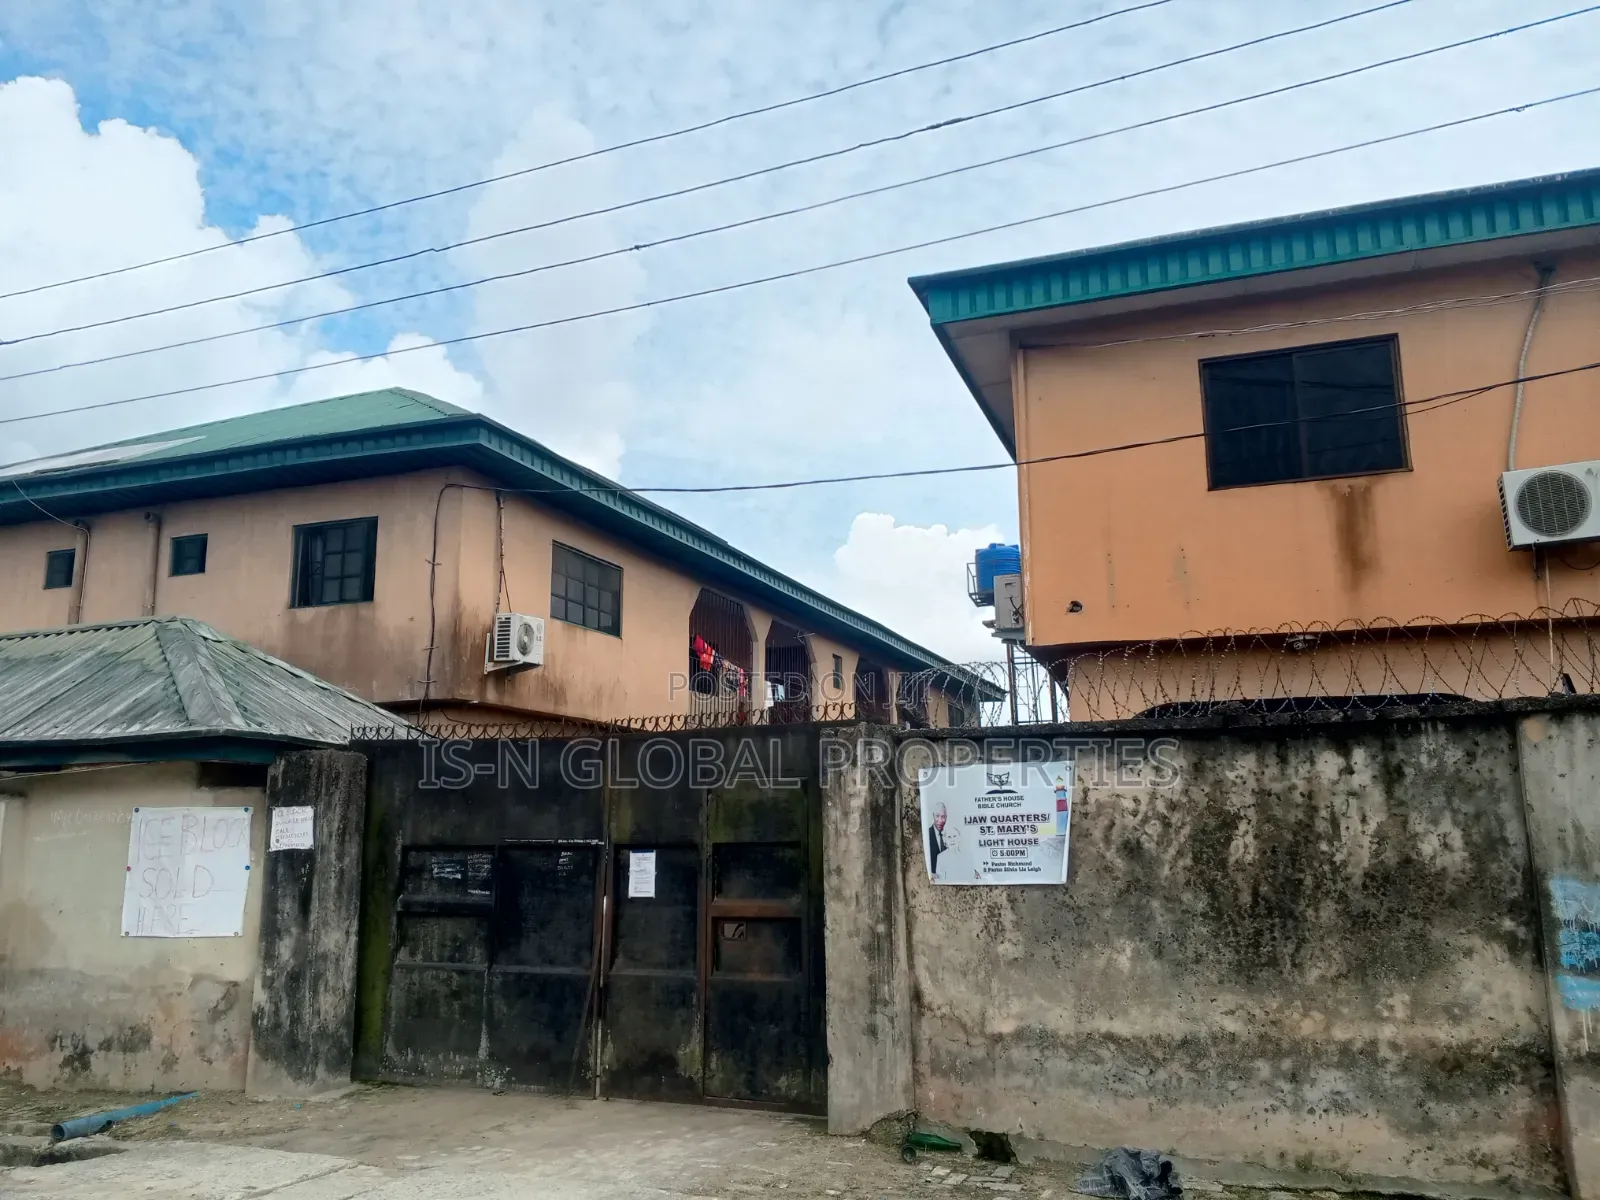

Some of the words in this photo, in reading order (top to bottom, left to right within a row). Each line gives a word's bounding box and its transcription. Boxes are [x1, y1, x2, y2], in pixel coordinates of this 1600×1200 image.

[964, 815, 988, 825] IJAW
[979, 825, 995, 835] ST.
[997, 824, 1039, 835] MARY'S
[137, 817, 175, 864] ICE
[978, 839, 1005, 847] LIGHT
[1007, 838, 1039, 846] HOUSE
[140, 865, 214, 900] SOLD
